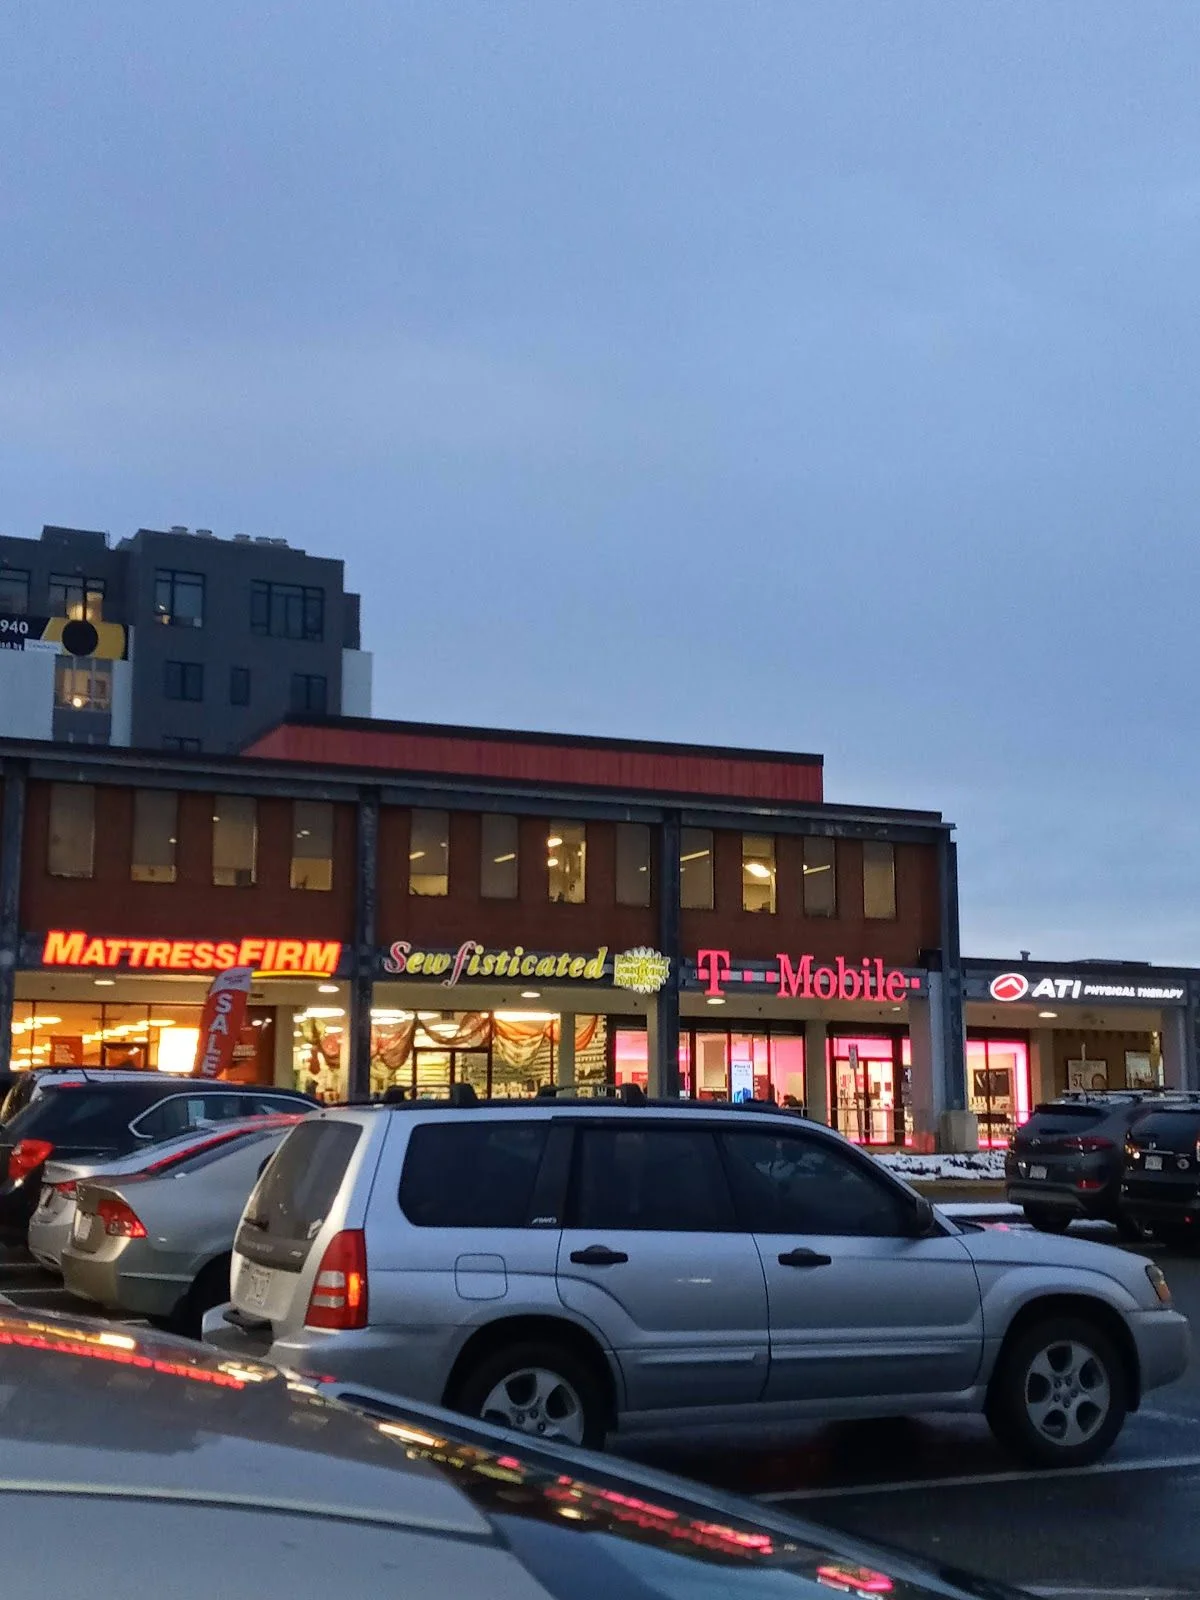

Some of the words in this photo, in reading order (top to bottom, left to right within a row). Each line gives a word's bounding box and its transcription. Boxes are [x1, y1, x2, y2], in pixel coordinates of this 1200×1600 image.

[1031, 978, 1082, 999] ATI
[1084, 984, 1135, 997] PHYSICAL
[1137, 987, 1184, 999] THERAPY
[201, 992, 233, 1076] SALE
